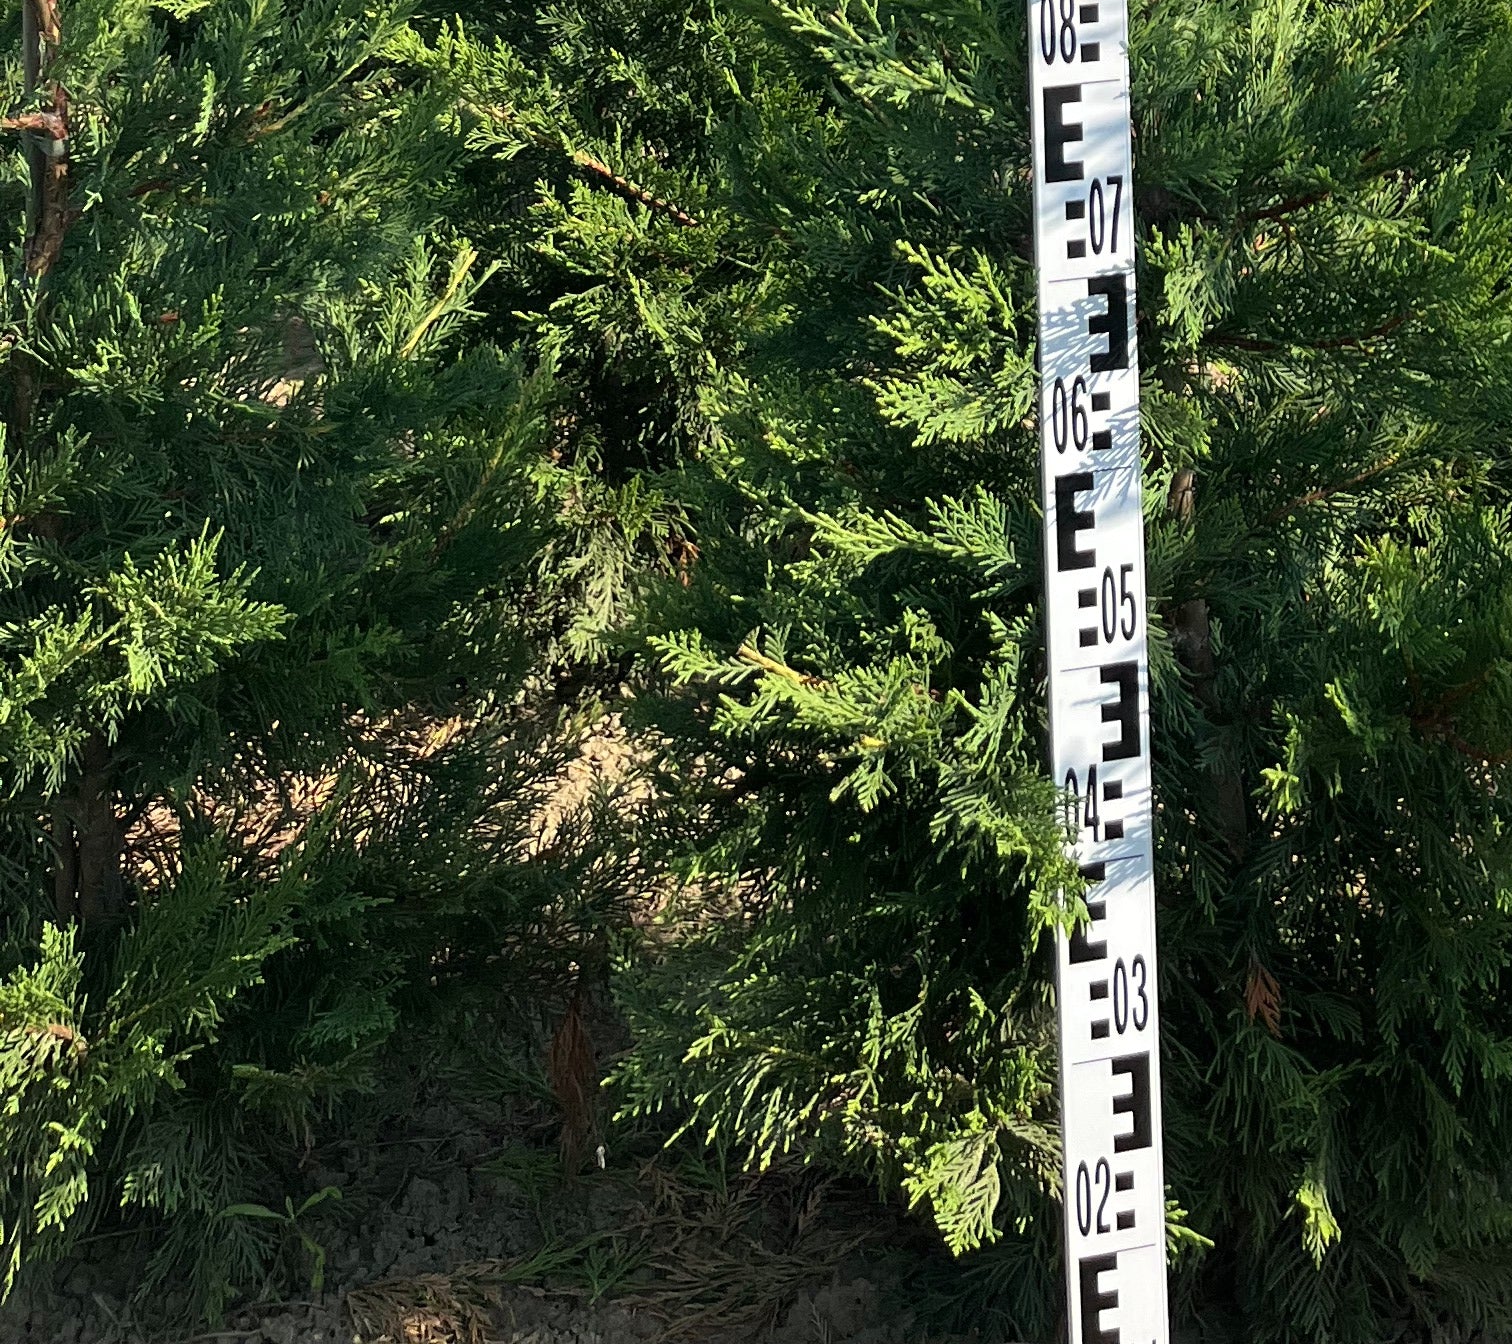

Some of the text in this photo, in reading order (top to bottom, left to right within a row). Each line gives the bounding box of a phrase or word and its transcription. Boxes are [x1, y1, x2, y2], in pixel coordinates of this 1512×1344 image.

[1089, 174, 1123, 256] 07
[1052, 374, 1089, 455] 06
[1101, 562, 1137, 644] 05
[1113, 952, 1149, 1035] 03
[1075, 1155, 1111, 1238] 02
